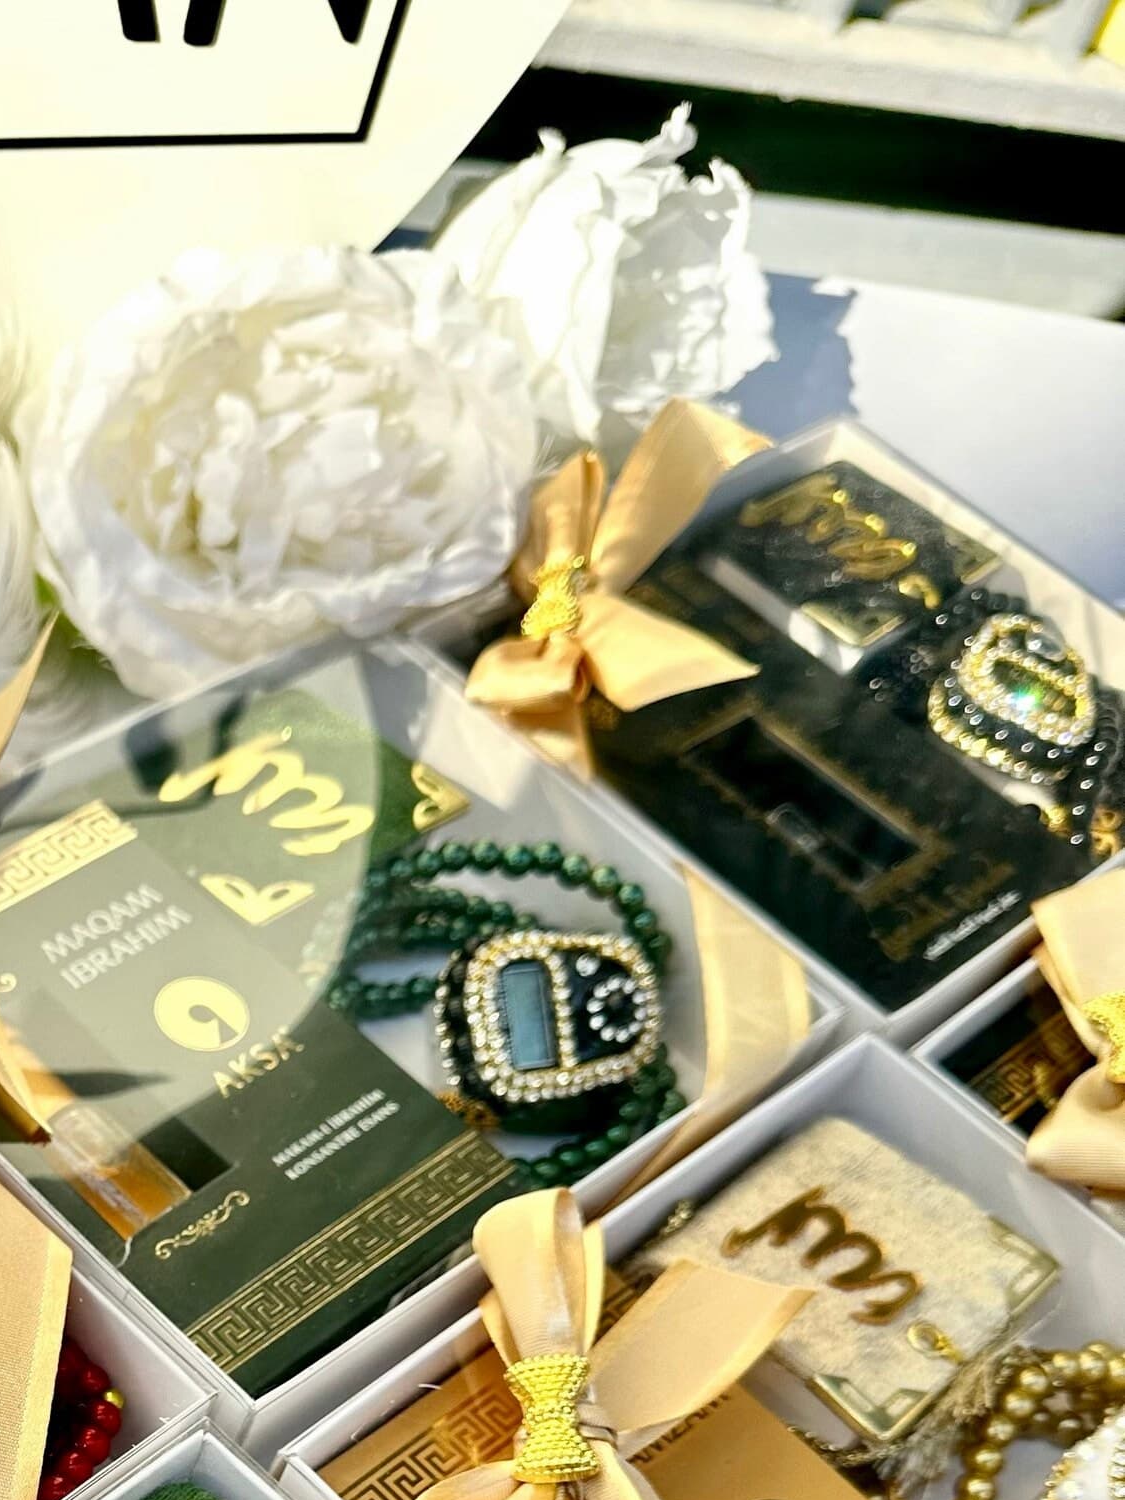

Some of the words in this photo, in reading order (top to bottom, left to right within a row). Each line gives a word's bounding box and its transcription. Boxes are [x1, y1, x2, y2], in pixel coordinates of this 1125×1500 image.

[41, 883, 163, 965] MAQAM
[59, 905, 193, 990] IBRAHIM
[213, 1025, 305, 1099] AKSA
